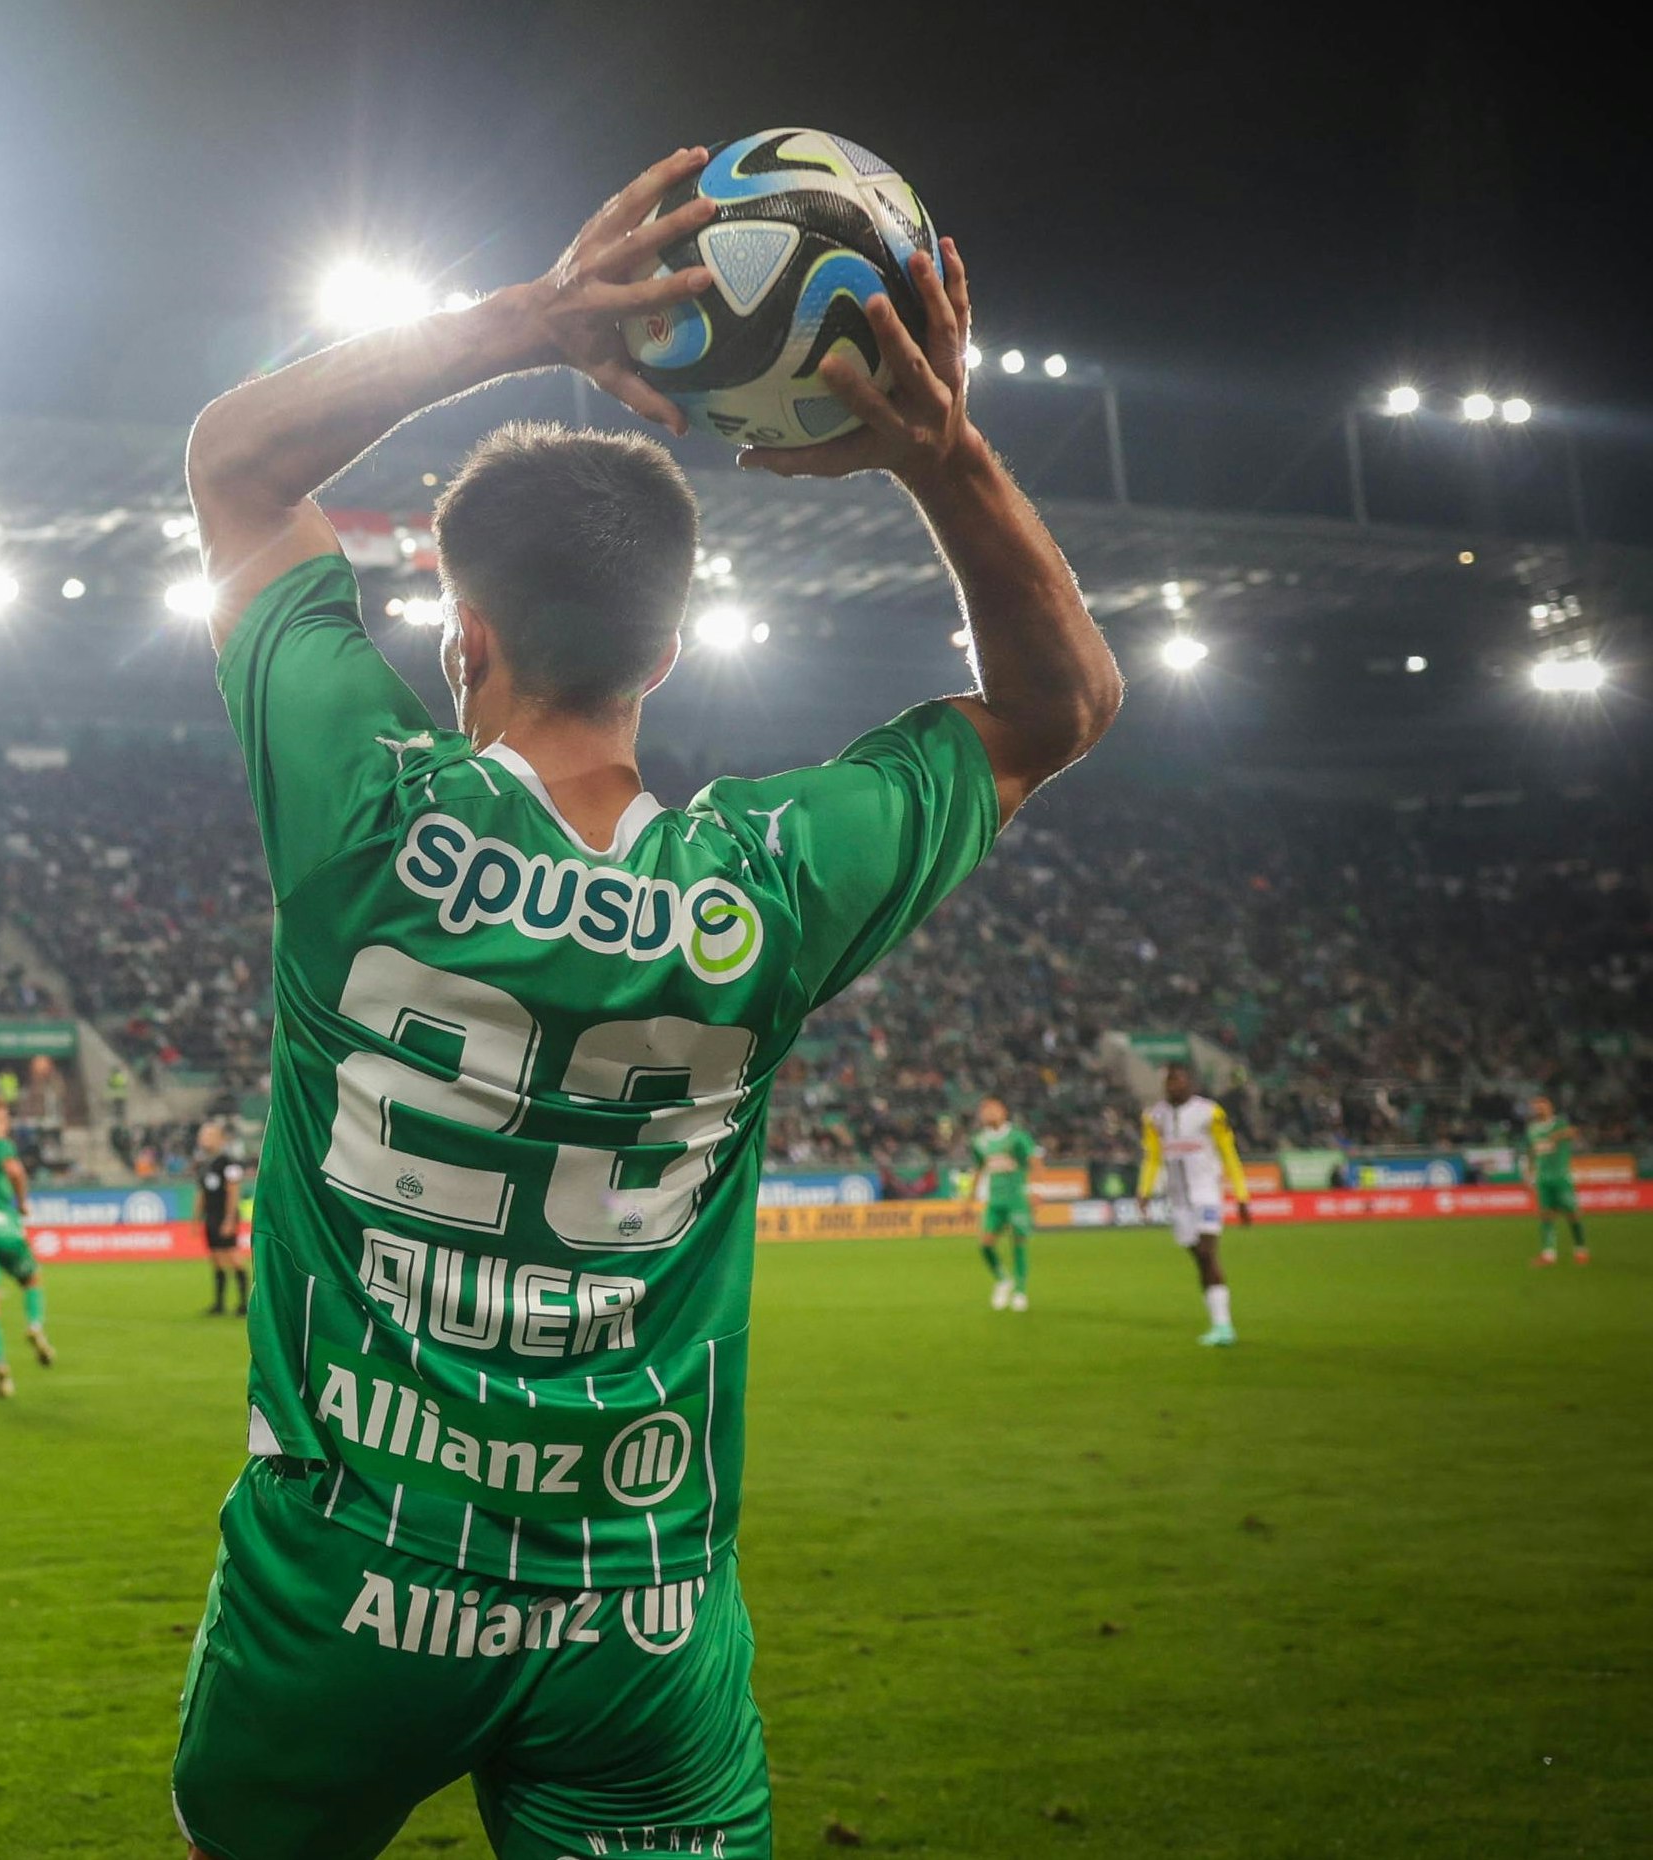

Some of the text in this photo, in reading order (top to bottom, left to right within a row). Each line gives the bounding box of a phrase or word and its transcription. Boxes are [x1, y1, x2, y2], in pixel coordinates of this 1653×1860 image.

[399, 816, 677, 957] spusu
[321, 945, 758, 1252] 23
[357, 1228, 645, 1357] AUER
[315, 1363, 584, 1493] Allianz
[342, 1569, 601, 1658] Allianz
[583, 1825, 726, 1860] WIENER
